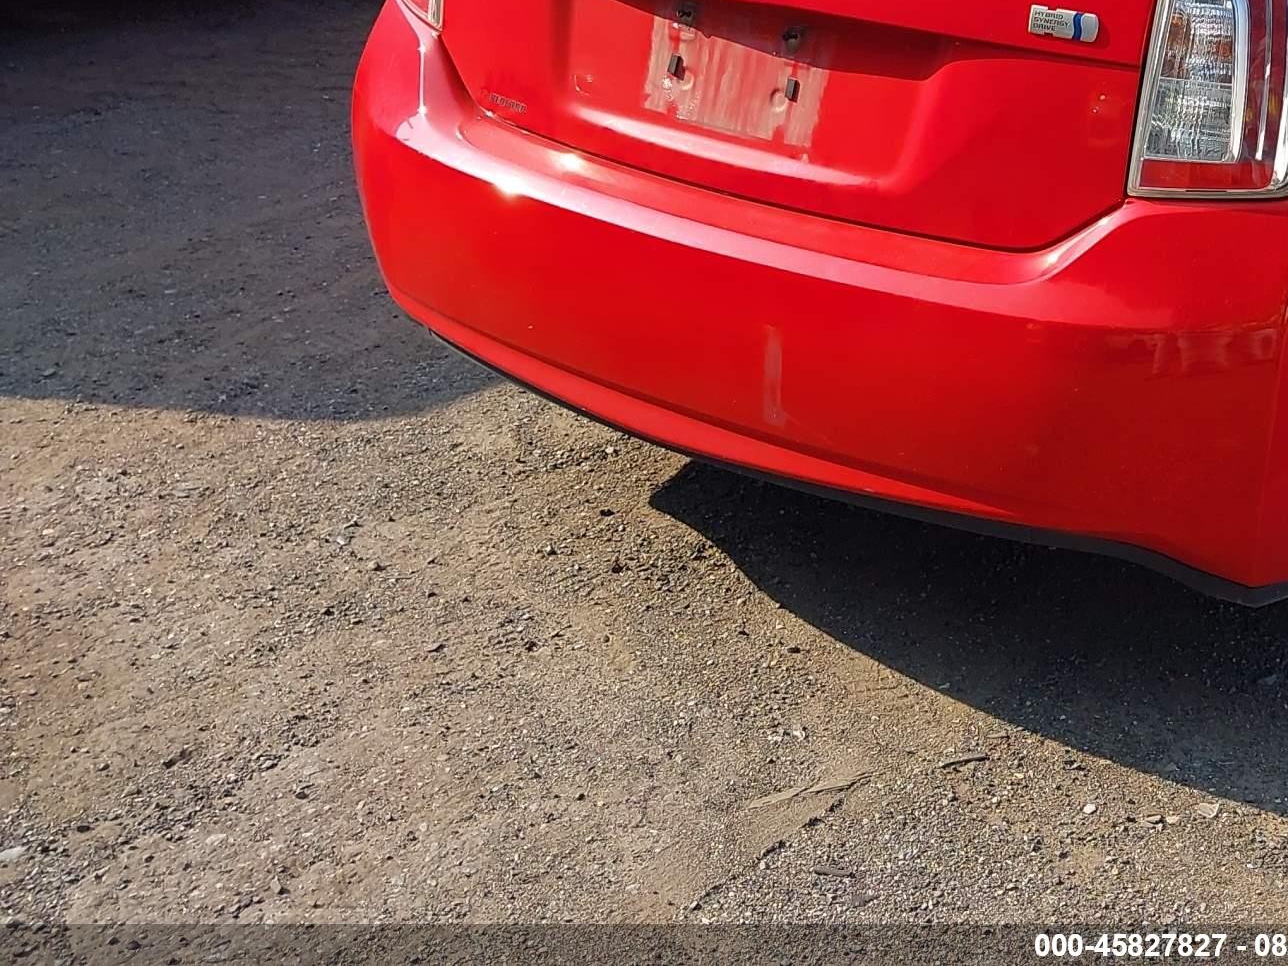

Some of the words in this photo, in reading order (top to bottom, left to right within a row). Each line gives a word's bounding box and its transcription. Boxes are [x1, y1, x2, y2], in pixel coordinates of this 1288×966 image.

[1034, 10, 1064, 20] HYBRID
[1033, 16, 1070, 29] SYNERGY
[1033, 23, 1056, 32] DRIVE
